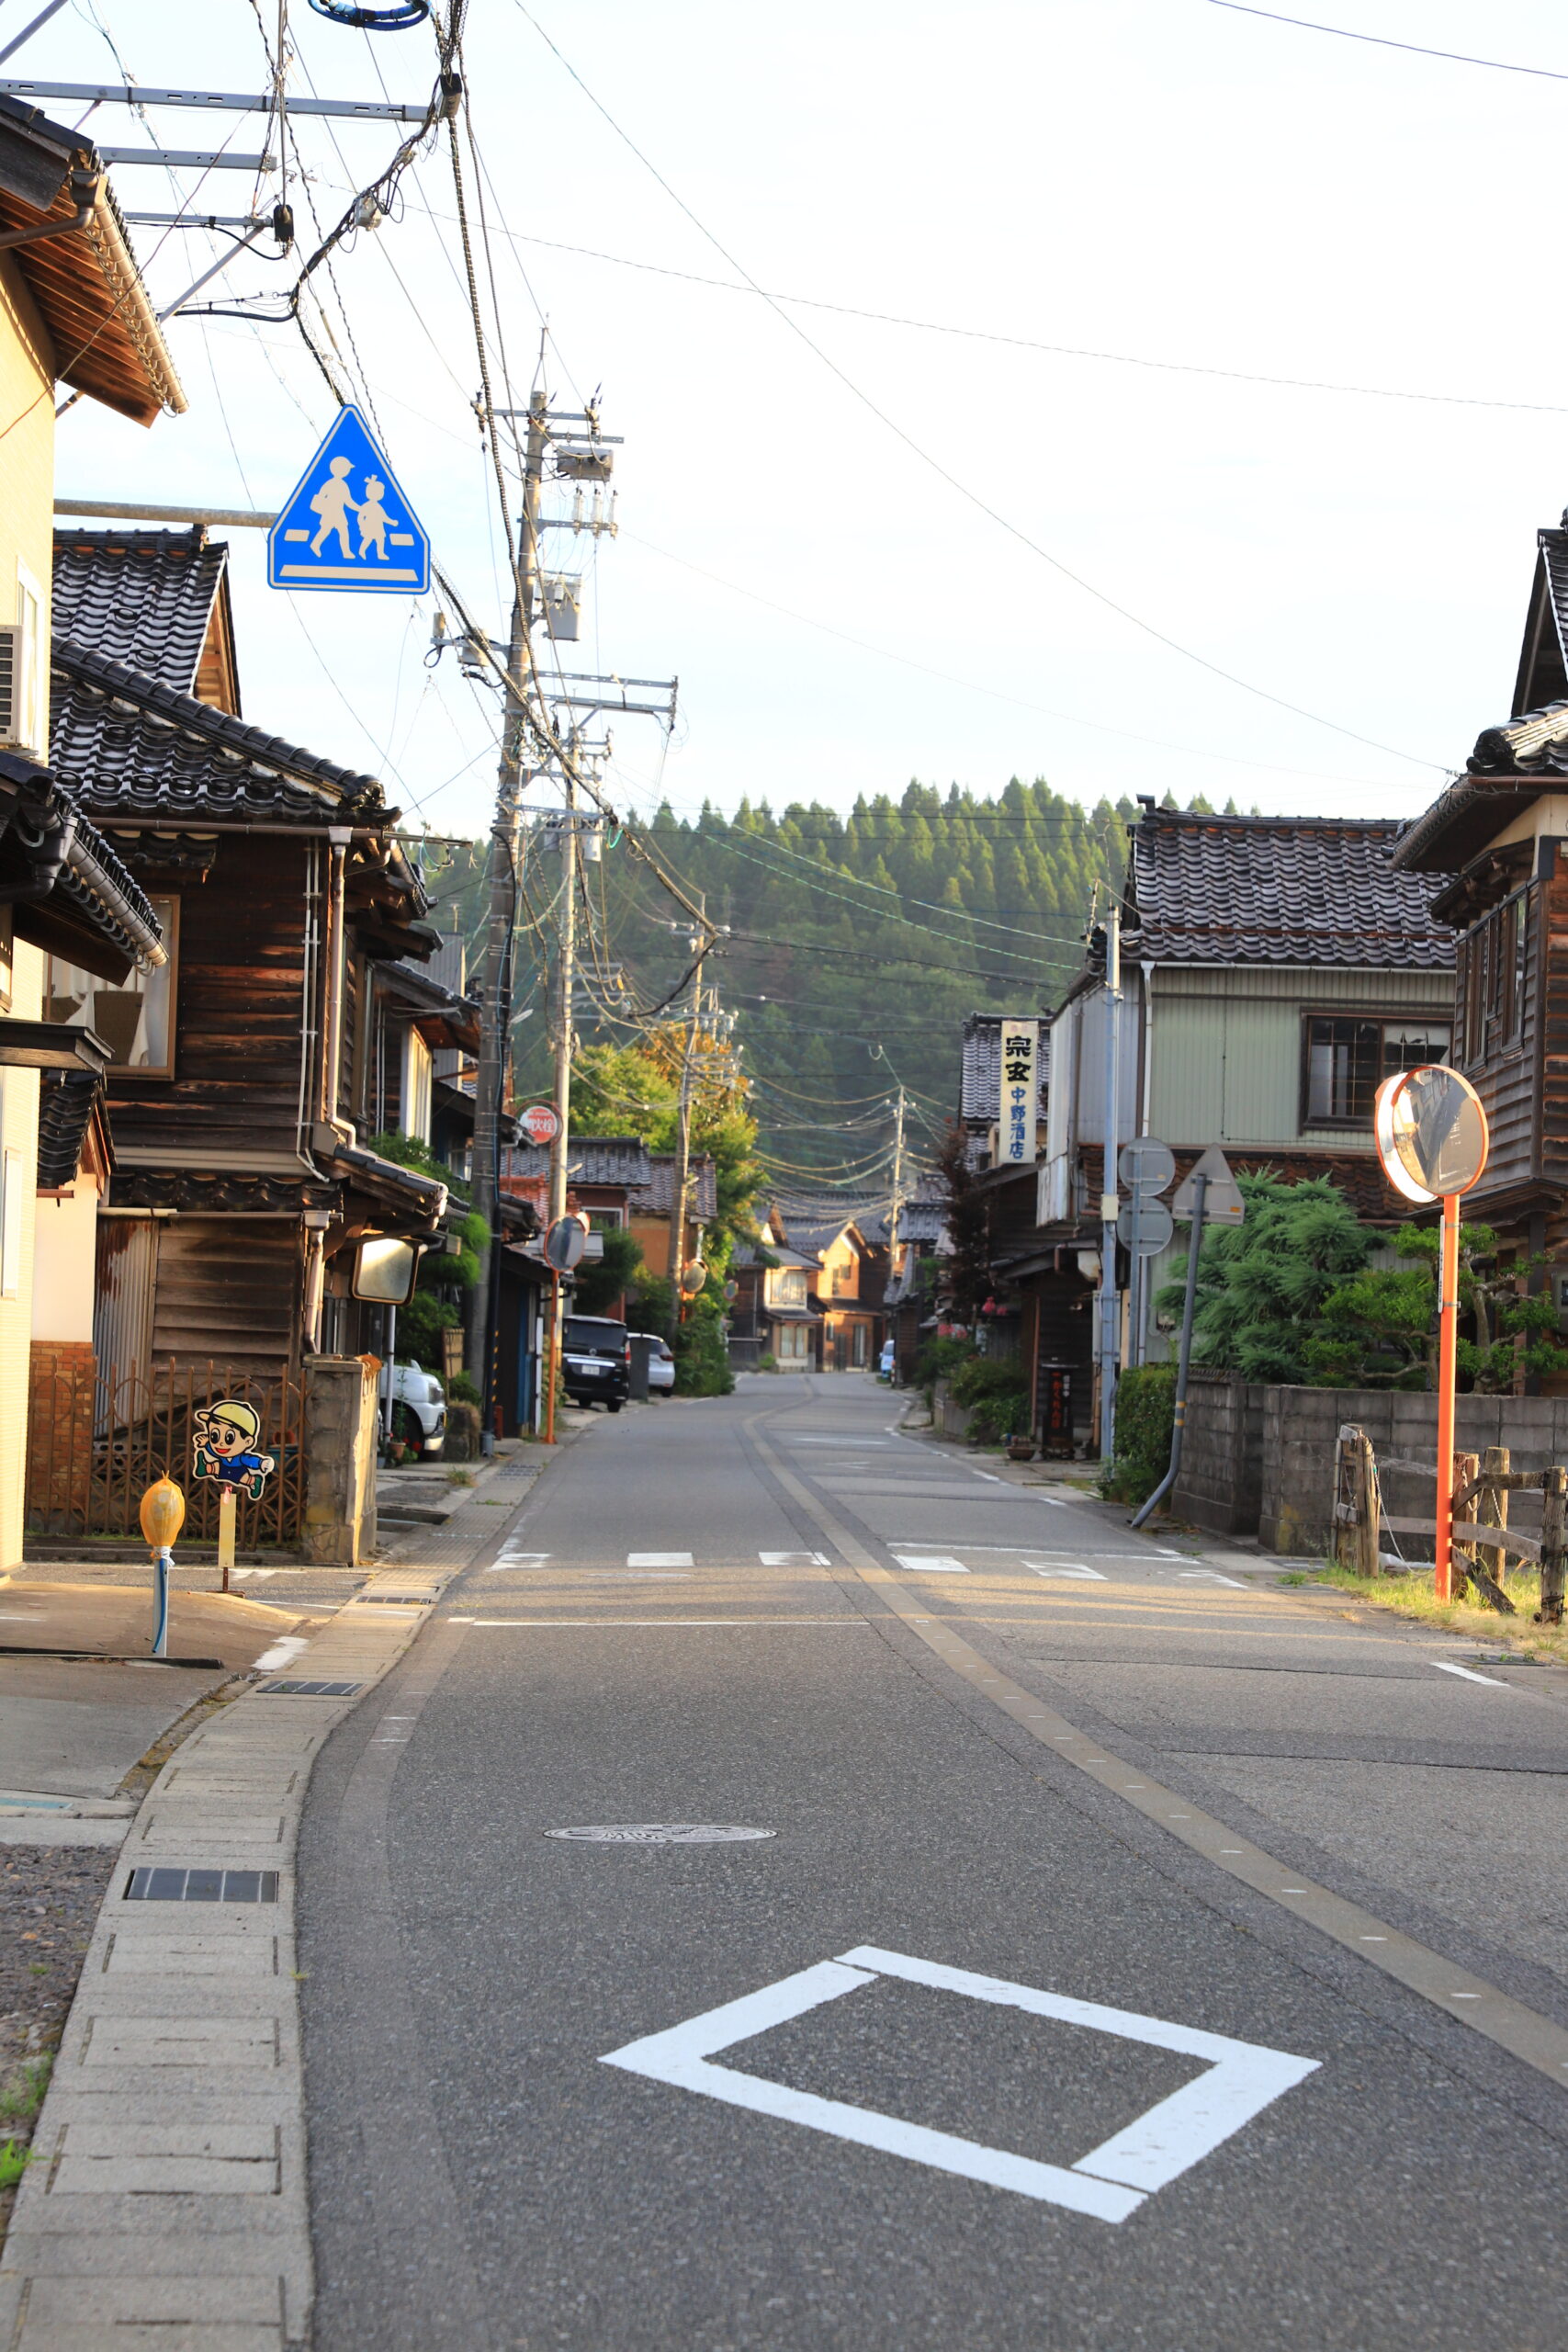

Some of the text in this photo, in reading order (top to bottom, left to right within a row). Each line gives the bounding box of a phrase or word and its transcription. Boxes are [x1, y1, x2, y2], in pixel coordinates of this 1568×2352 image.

[1005, 1035, 1032, 1082] 宗玄
[1010, 1086, 1026, 1159] 中野酒店
